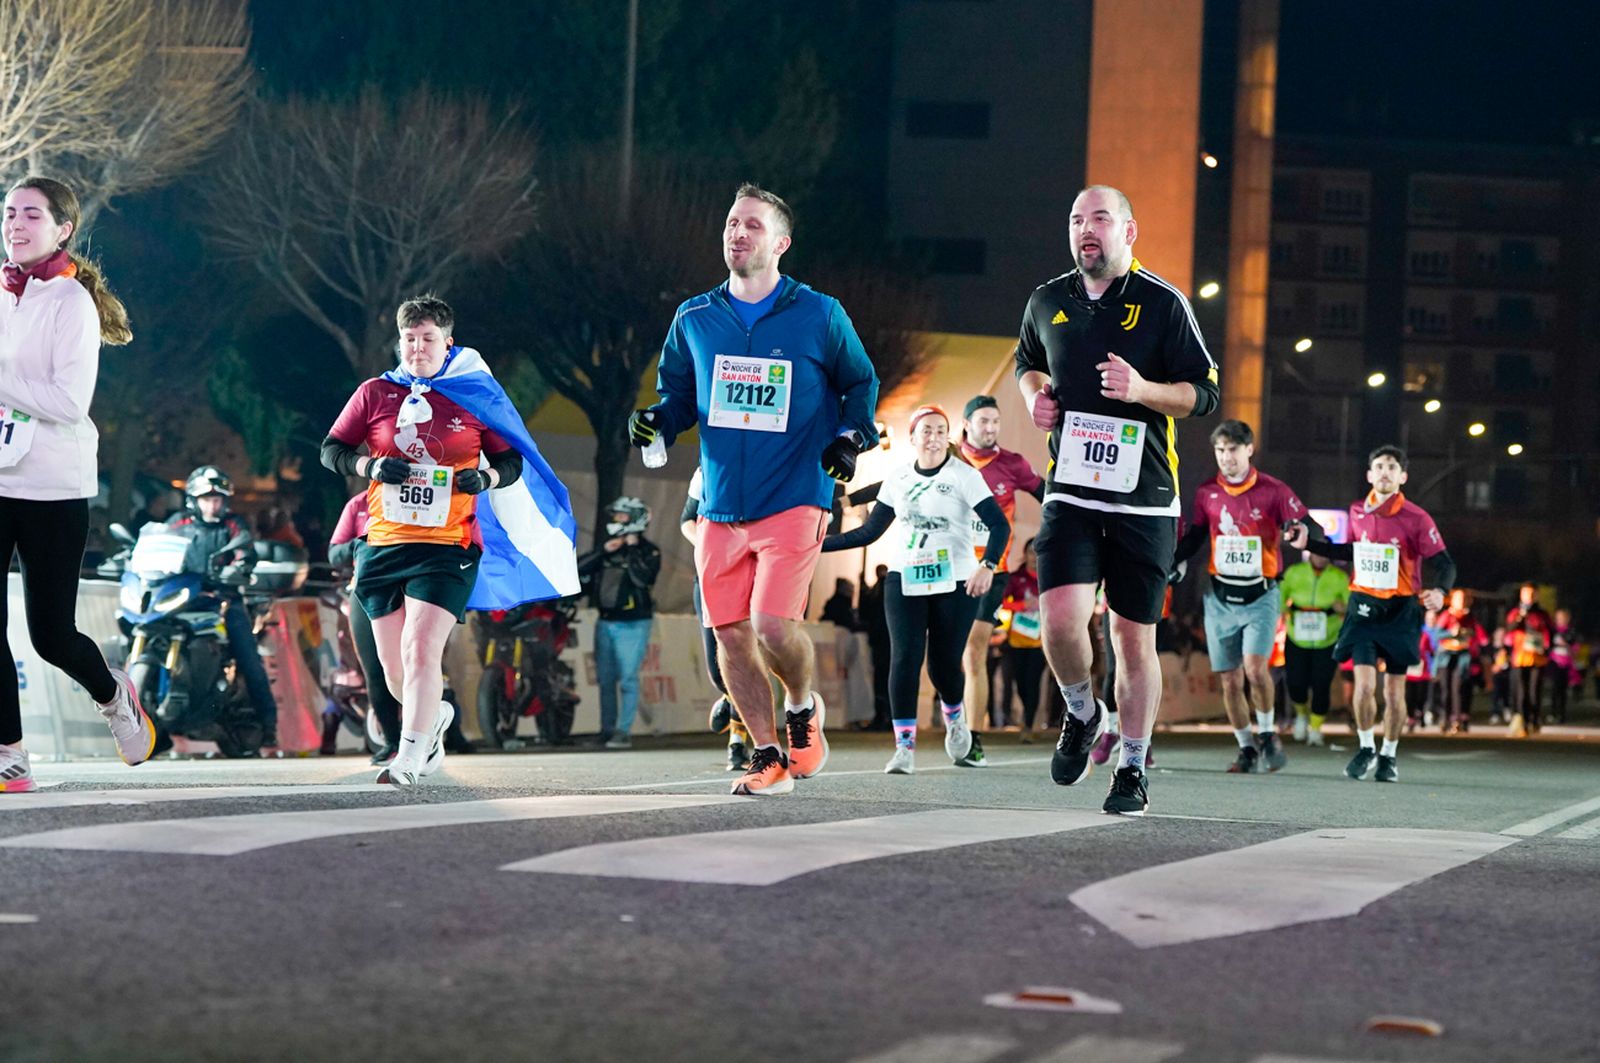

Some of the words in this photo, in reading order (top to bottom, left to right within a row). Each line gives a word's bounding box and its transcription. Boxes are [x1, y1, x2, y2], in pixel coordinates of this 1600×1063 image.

[721, 372, 737, 381] SAN
[731, 365, 751, 373] NOCHE
[753, 366, 762, 374] DE
[725, 382, 776, 407] 12112
[1071, 429, 1087, 438] SAN
[1081, 422, 1105, 431] NOCHE
[1106, 425, 1115, 433] DE
[406, 442, 424, 458] 43
[1083, 440, 1119, 465] 109
[399, 485, 434, 506] 569
[1224, 551, 1252, 565] 2642
[1361, 558, 1389, 573] 5398
[913, 563, 942, 579] 7751
